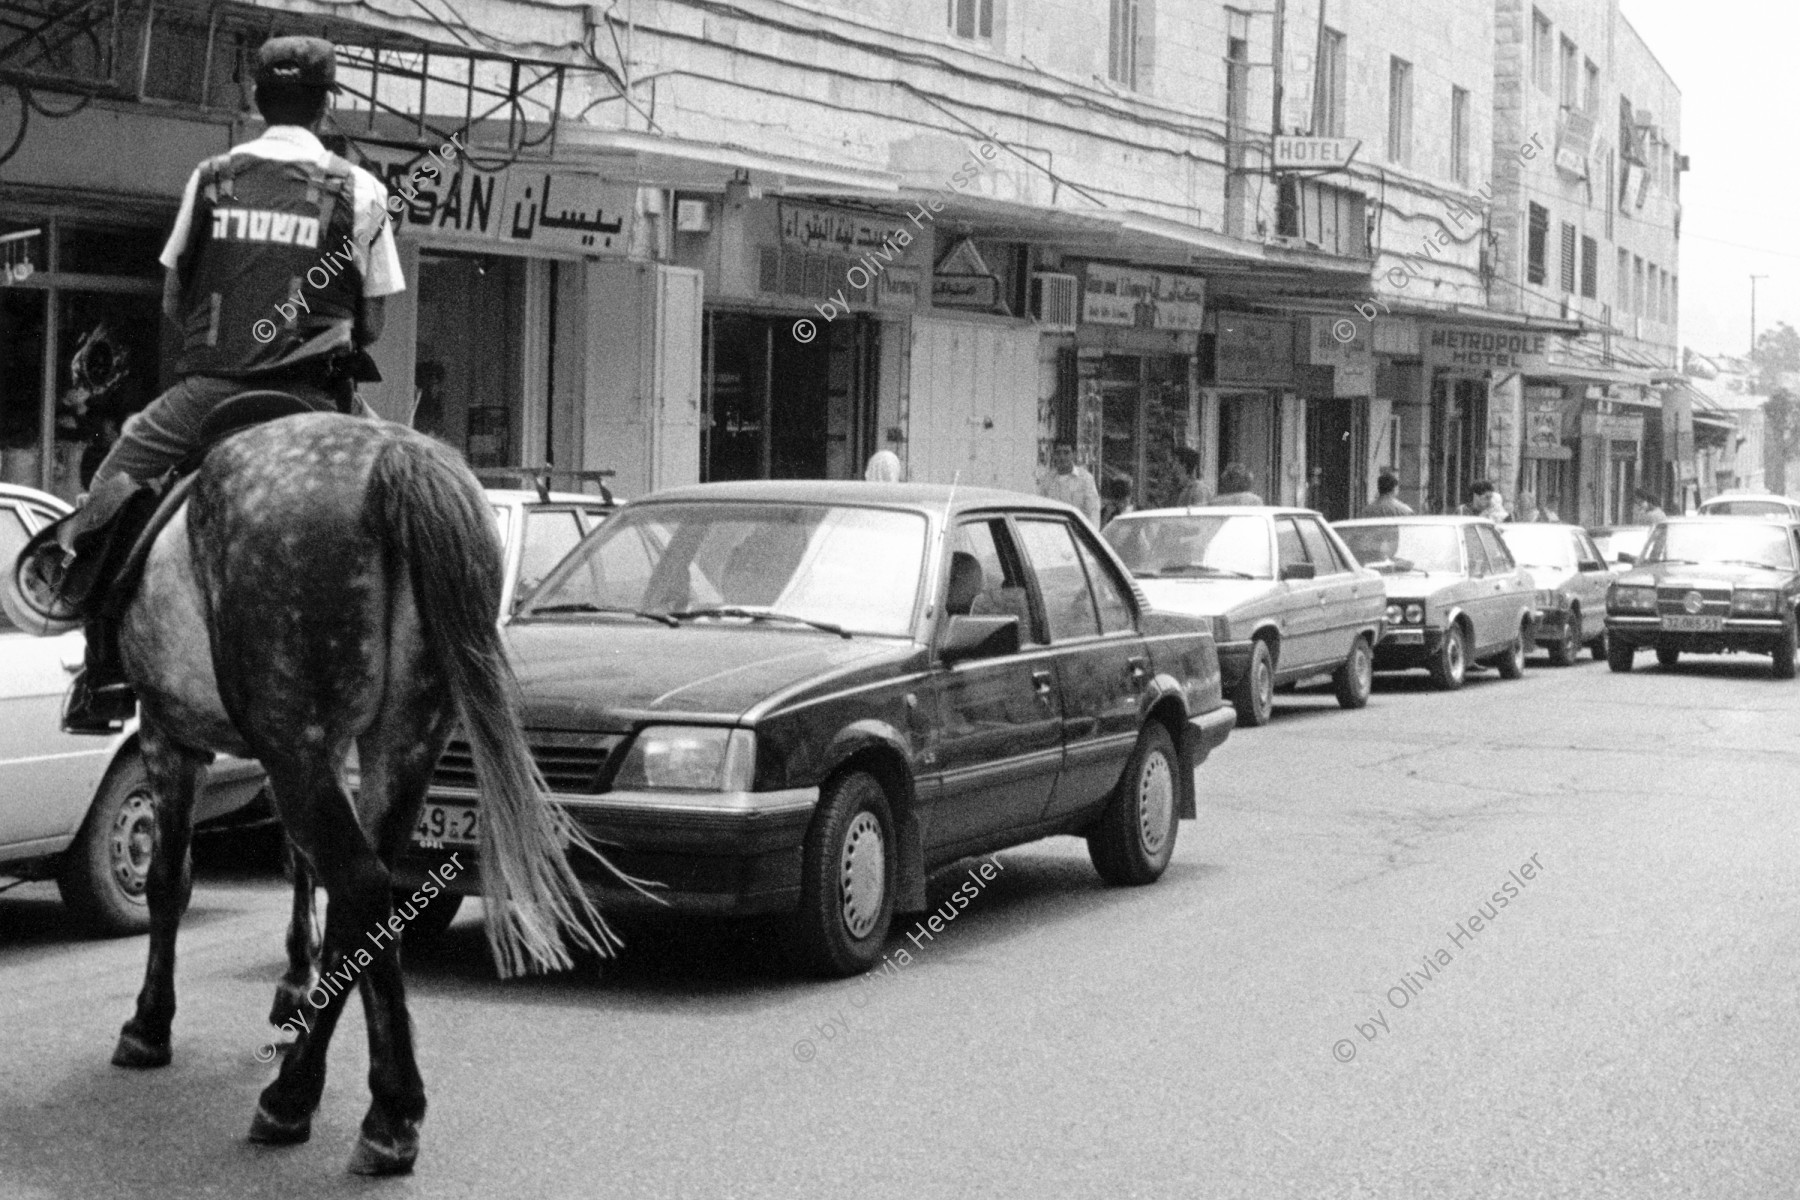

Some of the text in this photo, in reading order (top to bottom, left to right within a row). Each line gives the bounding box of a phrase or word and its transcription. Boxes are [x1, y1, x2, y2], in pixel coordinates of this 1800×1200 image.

[1280, 142, 1344, 161] HOTEL
[212, 208, 320, 249] משטרה
[1431, 330, 1546, 355] METROPOLE
[1452, 351, 1522, 368] HOTEL
